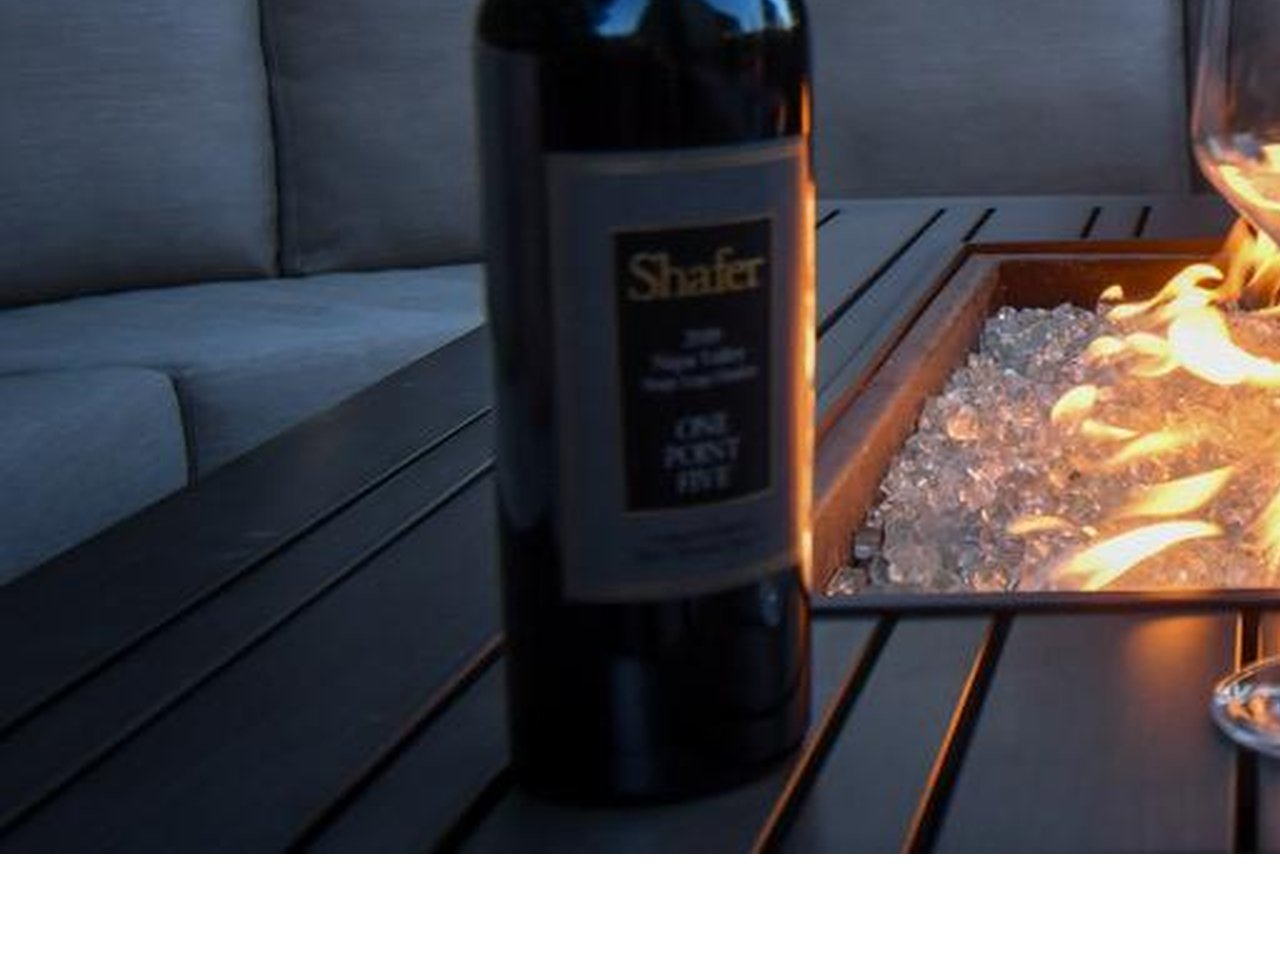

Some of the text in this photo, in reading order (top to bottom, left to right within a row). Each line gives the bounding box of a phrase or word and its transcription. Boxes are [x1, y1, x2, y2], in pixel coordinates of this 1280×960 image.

[627, 246, 766, 301] Shafer
[674, 412, 726, 438] ONE
[664, 438, 741, 469] POINT
[676, 466, 731, 495] FIVE
